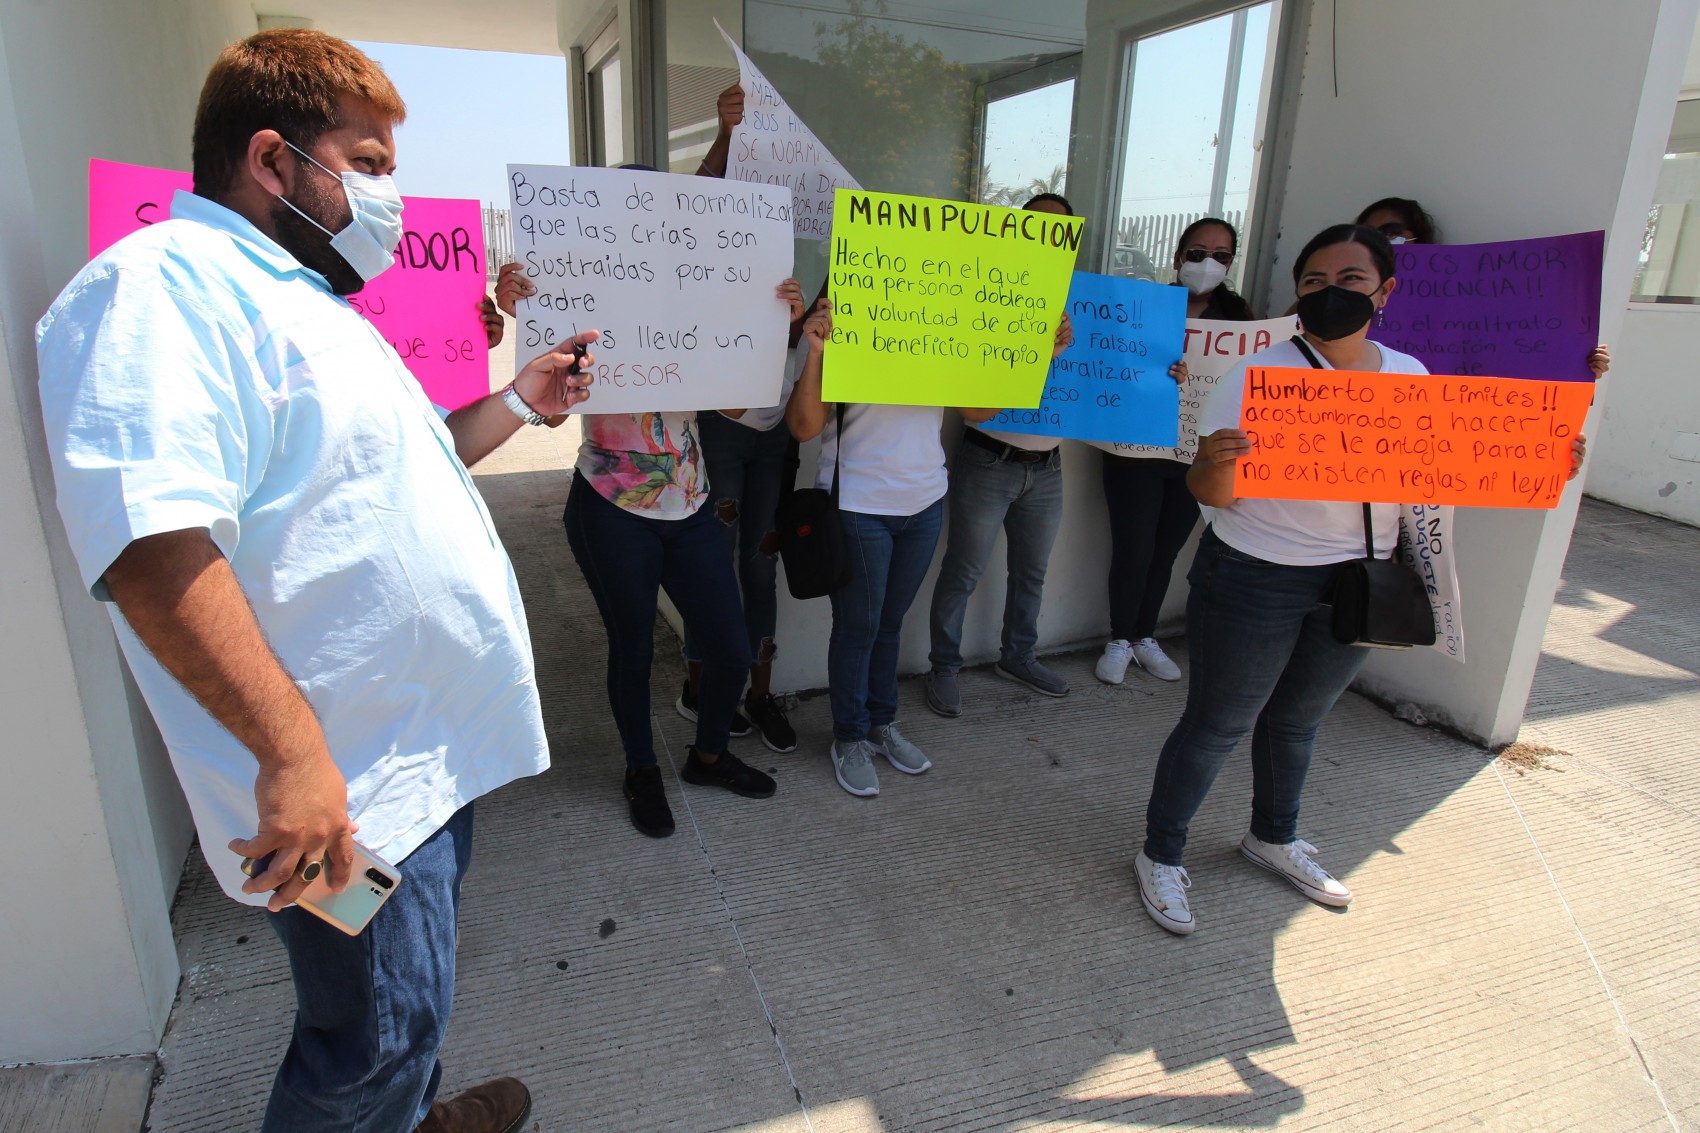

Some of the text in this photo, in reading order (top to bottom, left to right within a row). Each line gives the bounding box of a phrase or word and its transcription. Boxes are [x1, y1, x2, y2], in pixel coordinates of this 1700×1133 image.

[753, 110, 779, 132] SUS
[738, 132, 759, 163] SE
[511, 171, 793, 222] Basta de normalizar
[519, 215, 566, 245] que
[577, 216, 617, 244] las
[717, 230, 758, 249] son
[849, 194, 1084, 252] MANIPULACION
[835, 236, 907, 273] Hecho
[922, 258, 951, 277] en
[960, 256, 981, 280] el
[1477, 247, 1567, 273] AMOR
[676, 263, 715, 290] por
[724, 265, 752, 283] su
[833, 271, 1048, 320] una persona doblega
[833, 291, 1048, 335] la voluntad de otra
[1411, 314, 1431, 332] el
[1442, 313, 1562, 334] maltrato
[525, 319, 754, 350] Se ls llevó un
[830, 326, 859, 345] en
[978, 343, 1039, 369] propio
[1090, 333, 1148, 357] Falsas
[1183, 328, 1271, 356] TICIA
[597, 362, 683, 387] RESOR
[1051, 358, 1146, 383] paralizar
[1249, 369, 1374, 403] Humberto
[1393, 383, 1428, 403] sin
[1096, 390, 1121, 408] de
[1245, 403, 1570, 438] acostumbrado a hacer lo
[1298, 433, 1326, 454] se
[1341, 430, 1363, 453] le
[1376, 435, 1453, 466] antoja
[1473, 440, 1527, 463] para
[1535, 441, 1555, 461] el
[1242, 461, 1270, 481] no
[1284, 462, 1386, 486] existen
[1399, 468, 1468, 499] reglas
[1478, 471, 1498, 492] ni
[1428, 517, 1443, 555] NO
